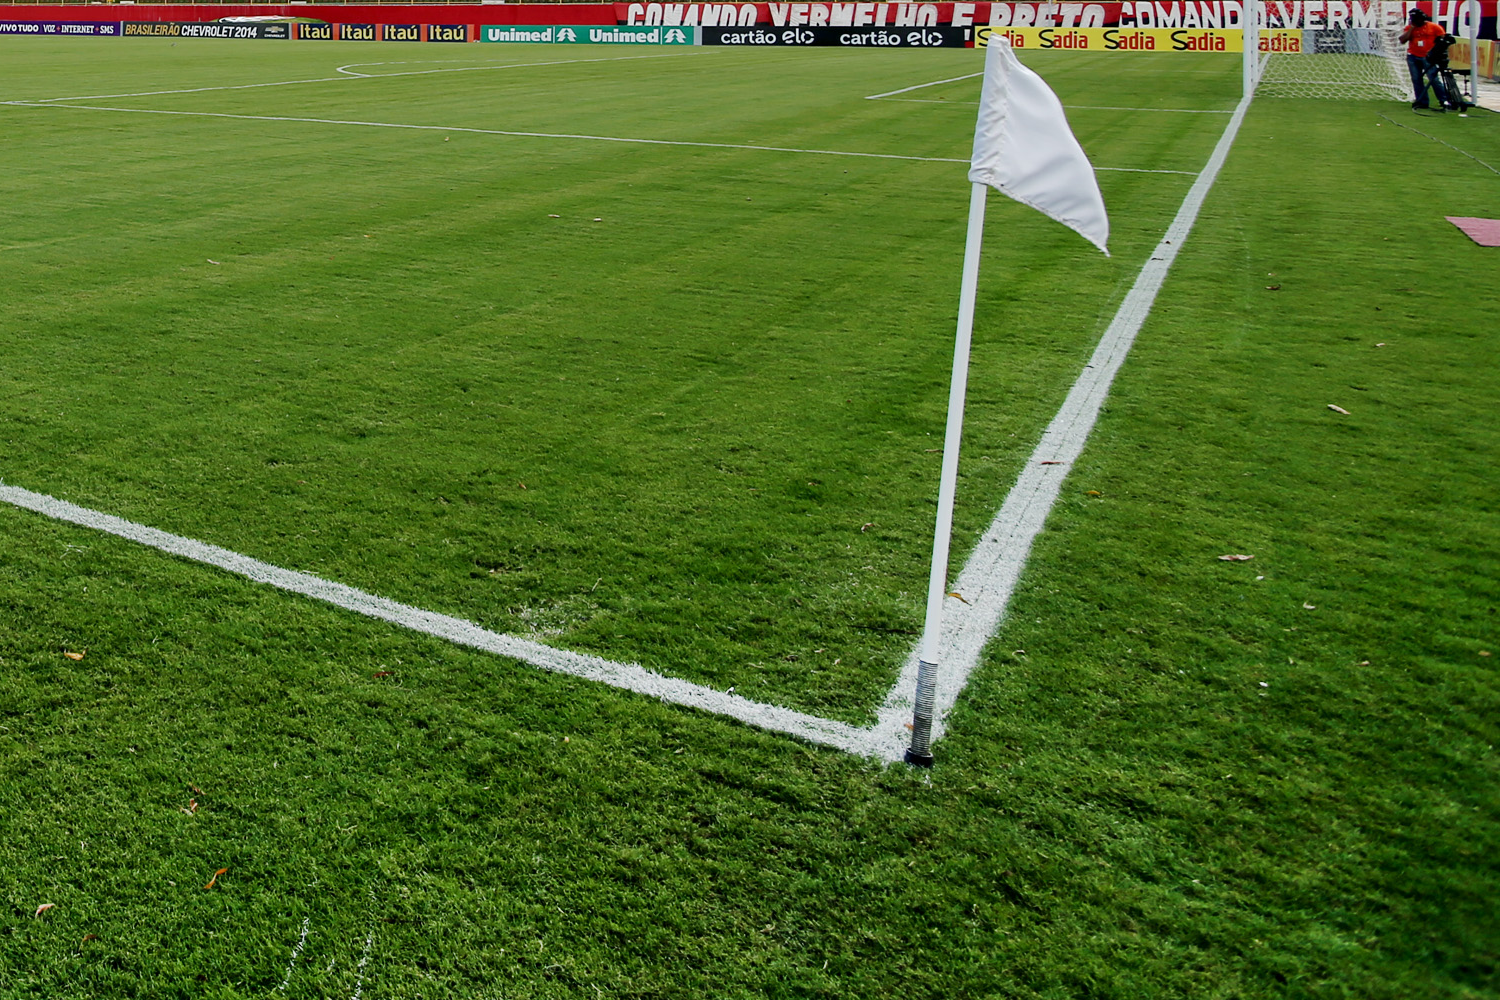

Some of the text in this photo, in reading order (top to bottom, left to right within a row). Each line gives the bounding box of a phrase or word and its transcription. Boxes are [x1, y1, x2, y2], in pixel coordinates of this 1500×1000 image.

[18, 24, 39, 33] TUDO
[43, 24, 56, 33] VOZ
[61, 24, 95, 34] INTERNET
[100, 25, 114, 34] SMS
[125, 22, 258, 38] BRASILEIRÃO CHEVROLET 2014
[299, 24, 331, 39] Itaú
[341, 25, 373, 40] Itaú
[384, 25, 418, 40] Itaú
[429, 25, 464, 41] Itaú
[487, 27, 552, 42] Unimed
[589, 28, 659, 43] Unimed
[720, 28, 815, 44] cartão elo
[840, 28, 943, 46] cartão elo
[1039, 28, 1088, 49] Sadia
[1103, 29, 1155, 50] Sadia
[1170, 30, 1225, 52] Sadia
